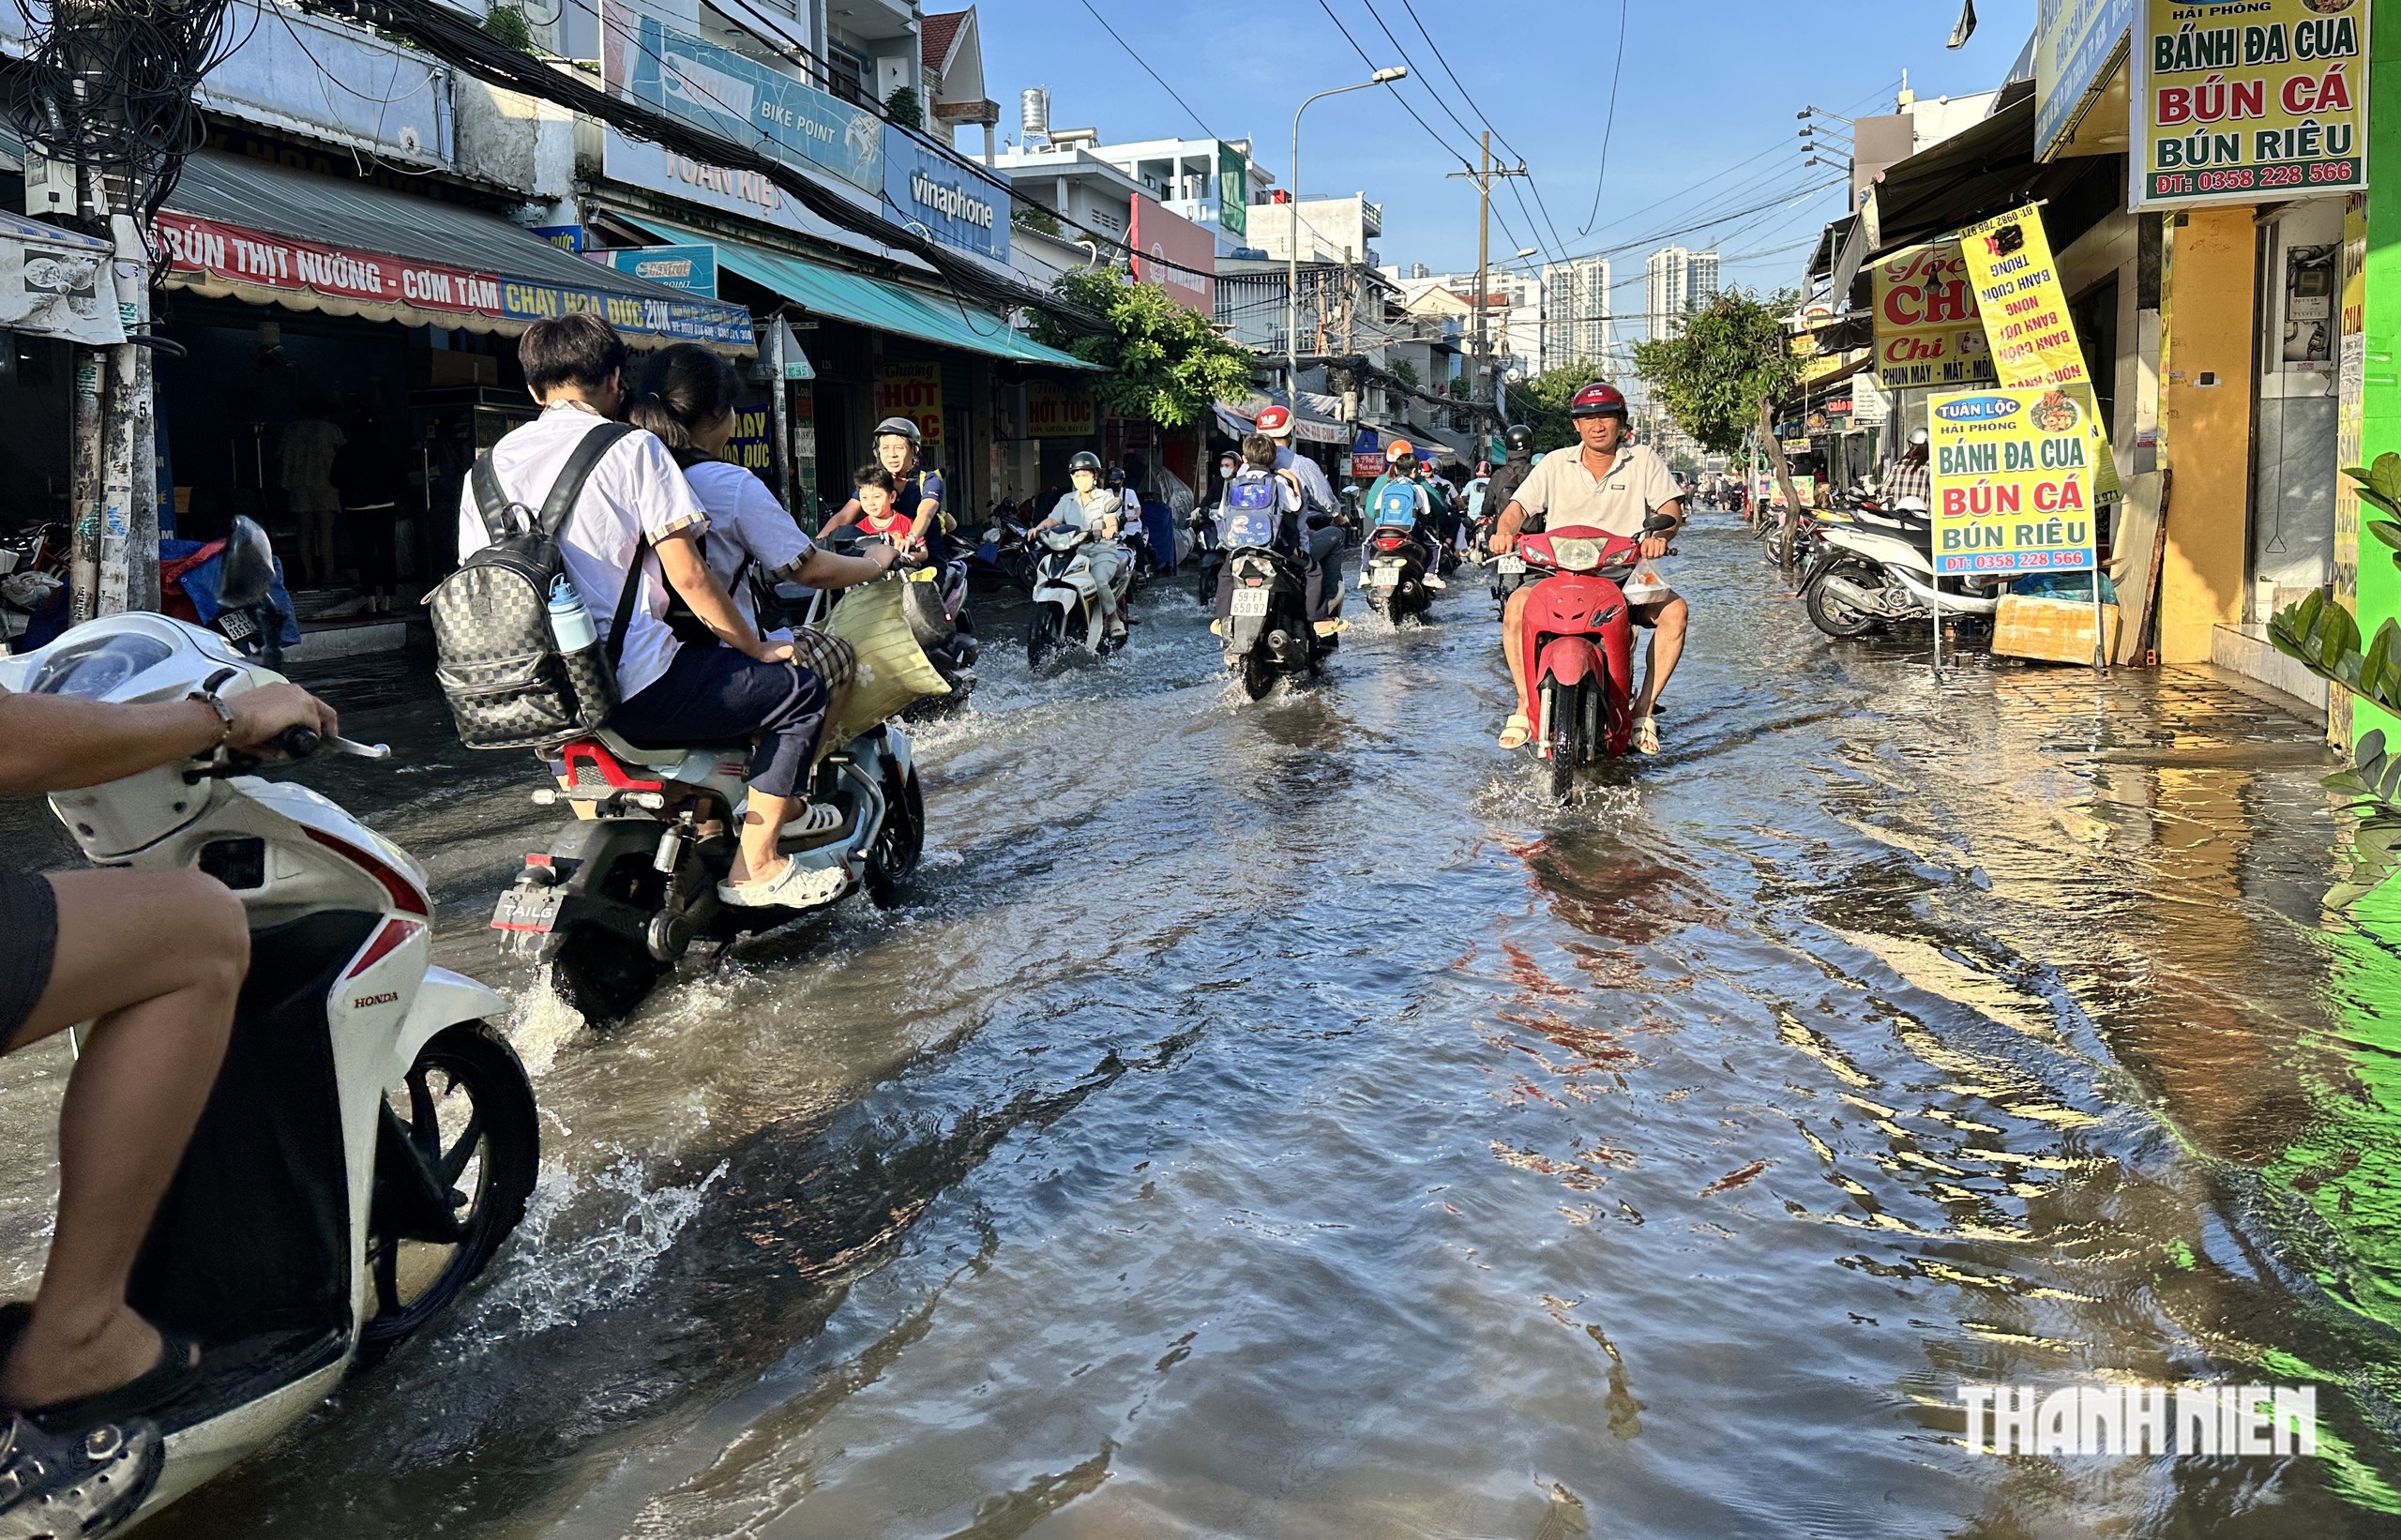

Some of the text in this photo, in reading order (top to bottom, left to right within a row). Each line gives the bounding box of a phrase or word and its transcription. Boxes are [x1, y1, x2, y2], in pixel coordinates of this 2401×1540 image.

[2173, 2, 2271, 20] HẢI PHÒNG
[2155, 18, 2354, 70] BÁNH ĐA CUA
[2158, 63, 2351, 124] BÚN CÁ
[762, 100, 836, 144] BIKE POINT
[2158, 120, 2351, 168] BÚN RIÊU
[2156, 162, 2351, 193] ĐT: 0358 228 566
[912, 172, 992, 229] vinaphone
[1962, 205, 2032, 239] ĐT: 0982 786 971
[163, 224, 226, 269] BÚN
[232, 238, 289, 283] THỊT
[402, 269, 452, 305] CƠM
[1990, 254, 2030, 278] TRỨNG
[2017, 269, 2051, 291] BÁNH
[506, 283, 558, 317] CHAY
[607, 295, 644, 328] ĐỨC
[644, 299, 671, 331] 20K
[2005, 295, 2039, 316] NÓNG
[2024, 311, 2059, 332] BÁNH
[2344, 304, 2362, 336] CUA
[1885, 336, 1947, 363] Chi
[2035, 330, 2070, 353] BÁNH
[1882, 367, 1910, 386] PHUN
[1910, 362, 1931, 384] MÀY
[1943, 355, 1963, 381] MẮT
[1973, 357, 1993, 378] MÔI
[884, 379, 939, 407] HỚT
[1029, 396, 1058, 423] HỚT
[1986, 400, 2016, 416] LỘC
[1940, 421, 2016, 434] HẢI PHÒNG
[744, 440, 770, 468] ĐỨC
[1939, 437, 2084, 475] BÁNH ĐA CUA
[1942, 474, 2083, 516] BÚN CÁ
[2102, 490, 2119, 503] 971
[1942, 517, 2086, 550] BÚN RIÊU
[1946, 552, 2082, 570] ĐT: 0358 228 566
[1238, 592, 1262, 603] 59-F1
[504, 904, 553, 918] TAILG
[354, 991, 398, 1008] HONDA
